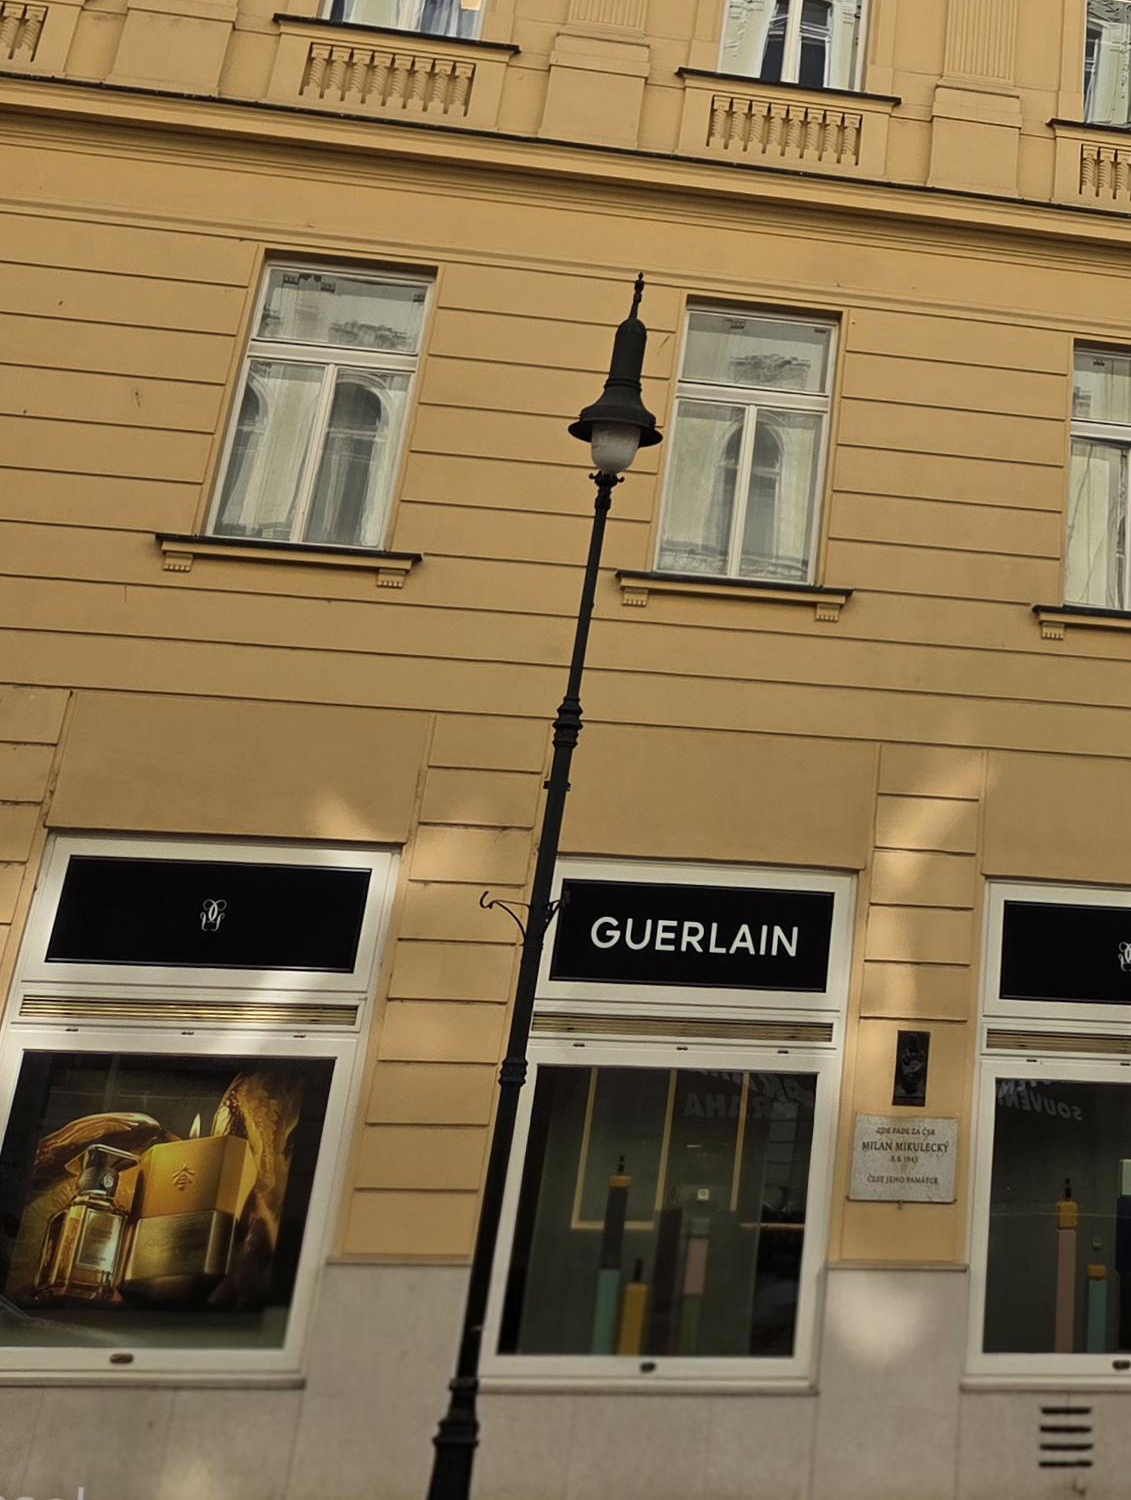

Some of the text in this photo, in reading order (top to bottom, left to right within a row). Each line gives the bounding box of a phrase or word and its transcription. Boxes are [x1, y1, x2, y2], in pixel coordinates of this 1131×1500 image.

[590, 916, 799, 957] GUERLAIN
[911, 1127, 921, 1135] ZA
[862, 1141, 949, 1152] MILAN MIKULECKÝ
[867, 1173, 884, 1183] ČEST
